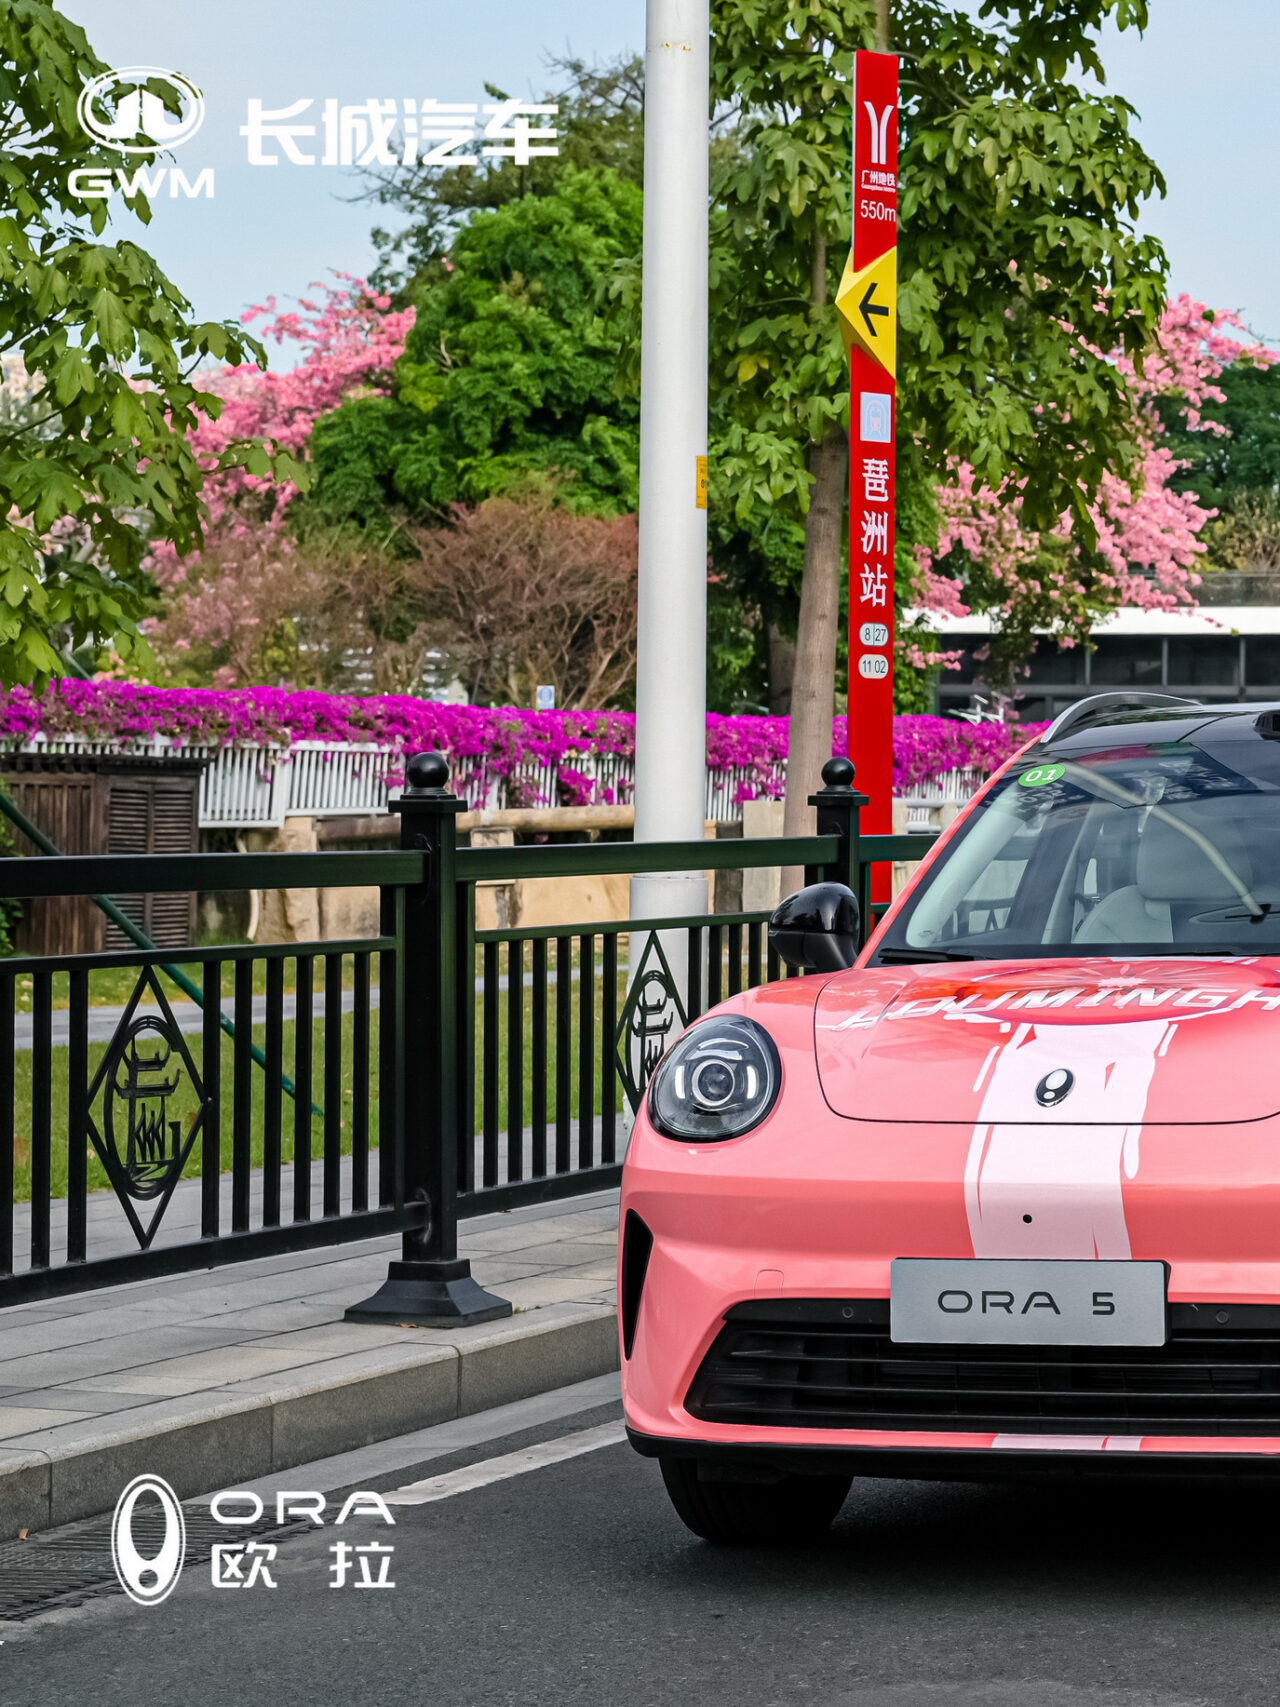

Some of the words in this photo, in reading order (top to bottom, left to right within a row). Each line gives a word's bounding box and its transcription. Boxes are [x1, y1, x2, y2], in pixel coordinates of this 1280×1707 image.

[860, 199, 896, 222] 550m
[860, 458, 889, 607] 琶洲站
[1025, 768, 1056, 783] 01
[937, 1289, 1061, 1315] ORA
[1092, 1291, 1115, 1316] 5
